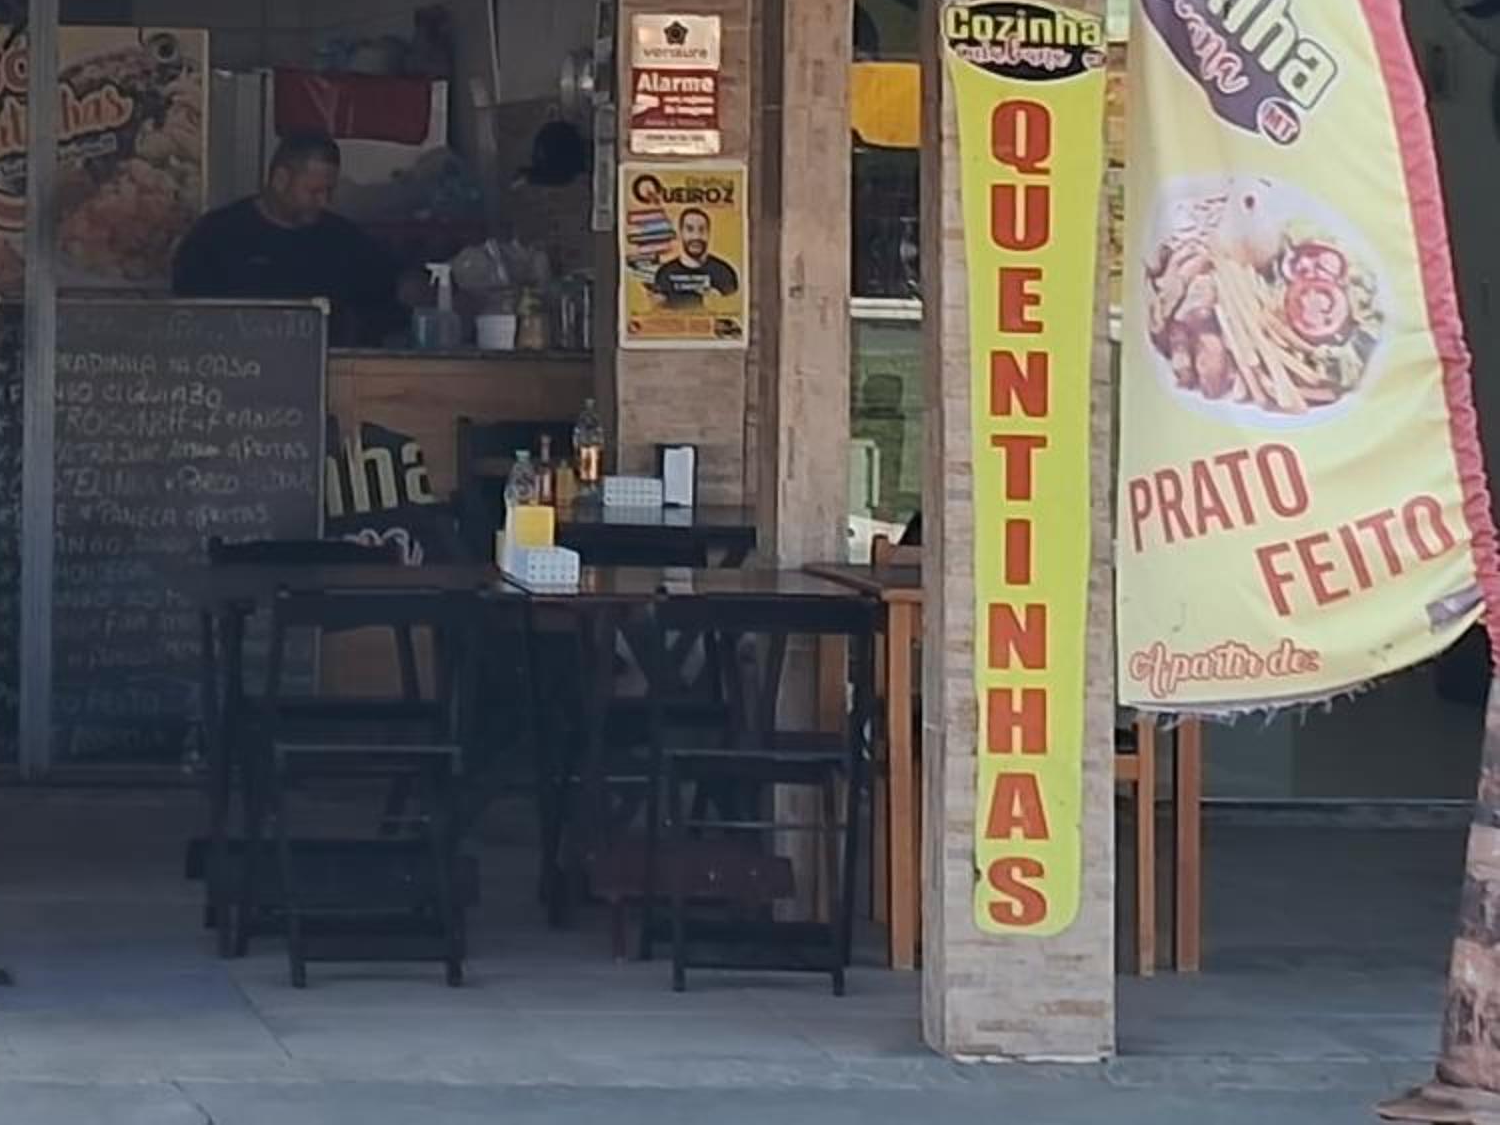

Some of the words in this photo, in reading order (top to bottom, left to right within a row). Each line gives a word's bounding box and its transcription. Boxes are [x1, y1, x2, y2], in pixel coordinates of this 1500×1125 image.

[946, 8, 1101, 46] Cozinha
[637, 73, 715, 92] Alarme
[1262, 104, 1299, 140] MT
[984, 99, 1054, 927] QUENTINHAS
[1128, 443, 1310, 553] PRATO
[1256, 494, 1455, 616] FEITO
